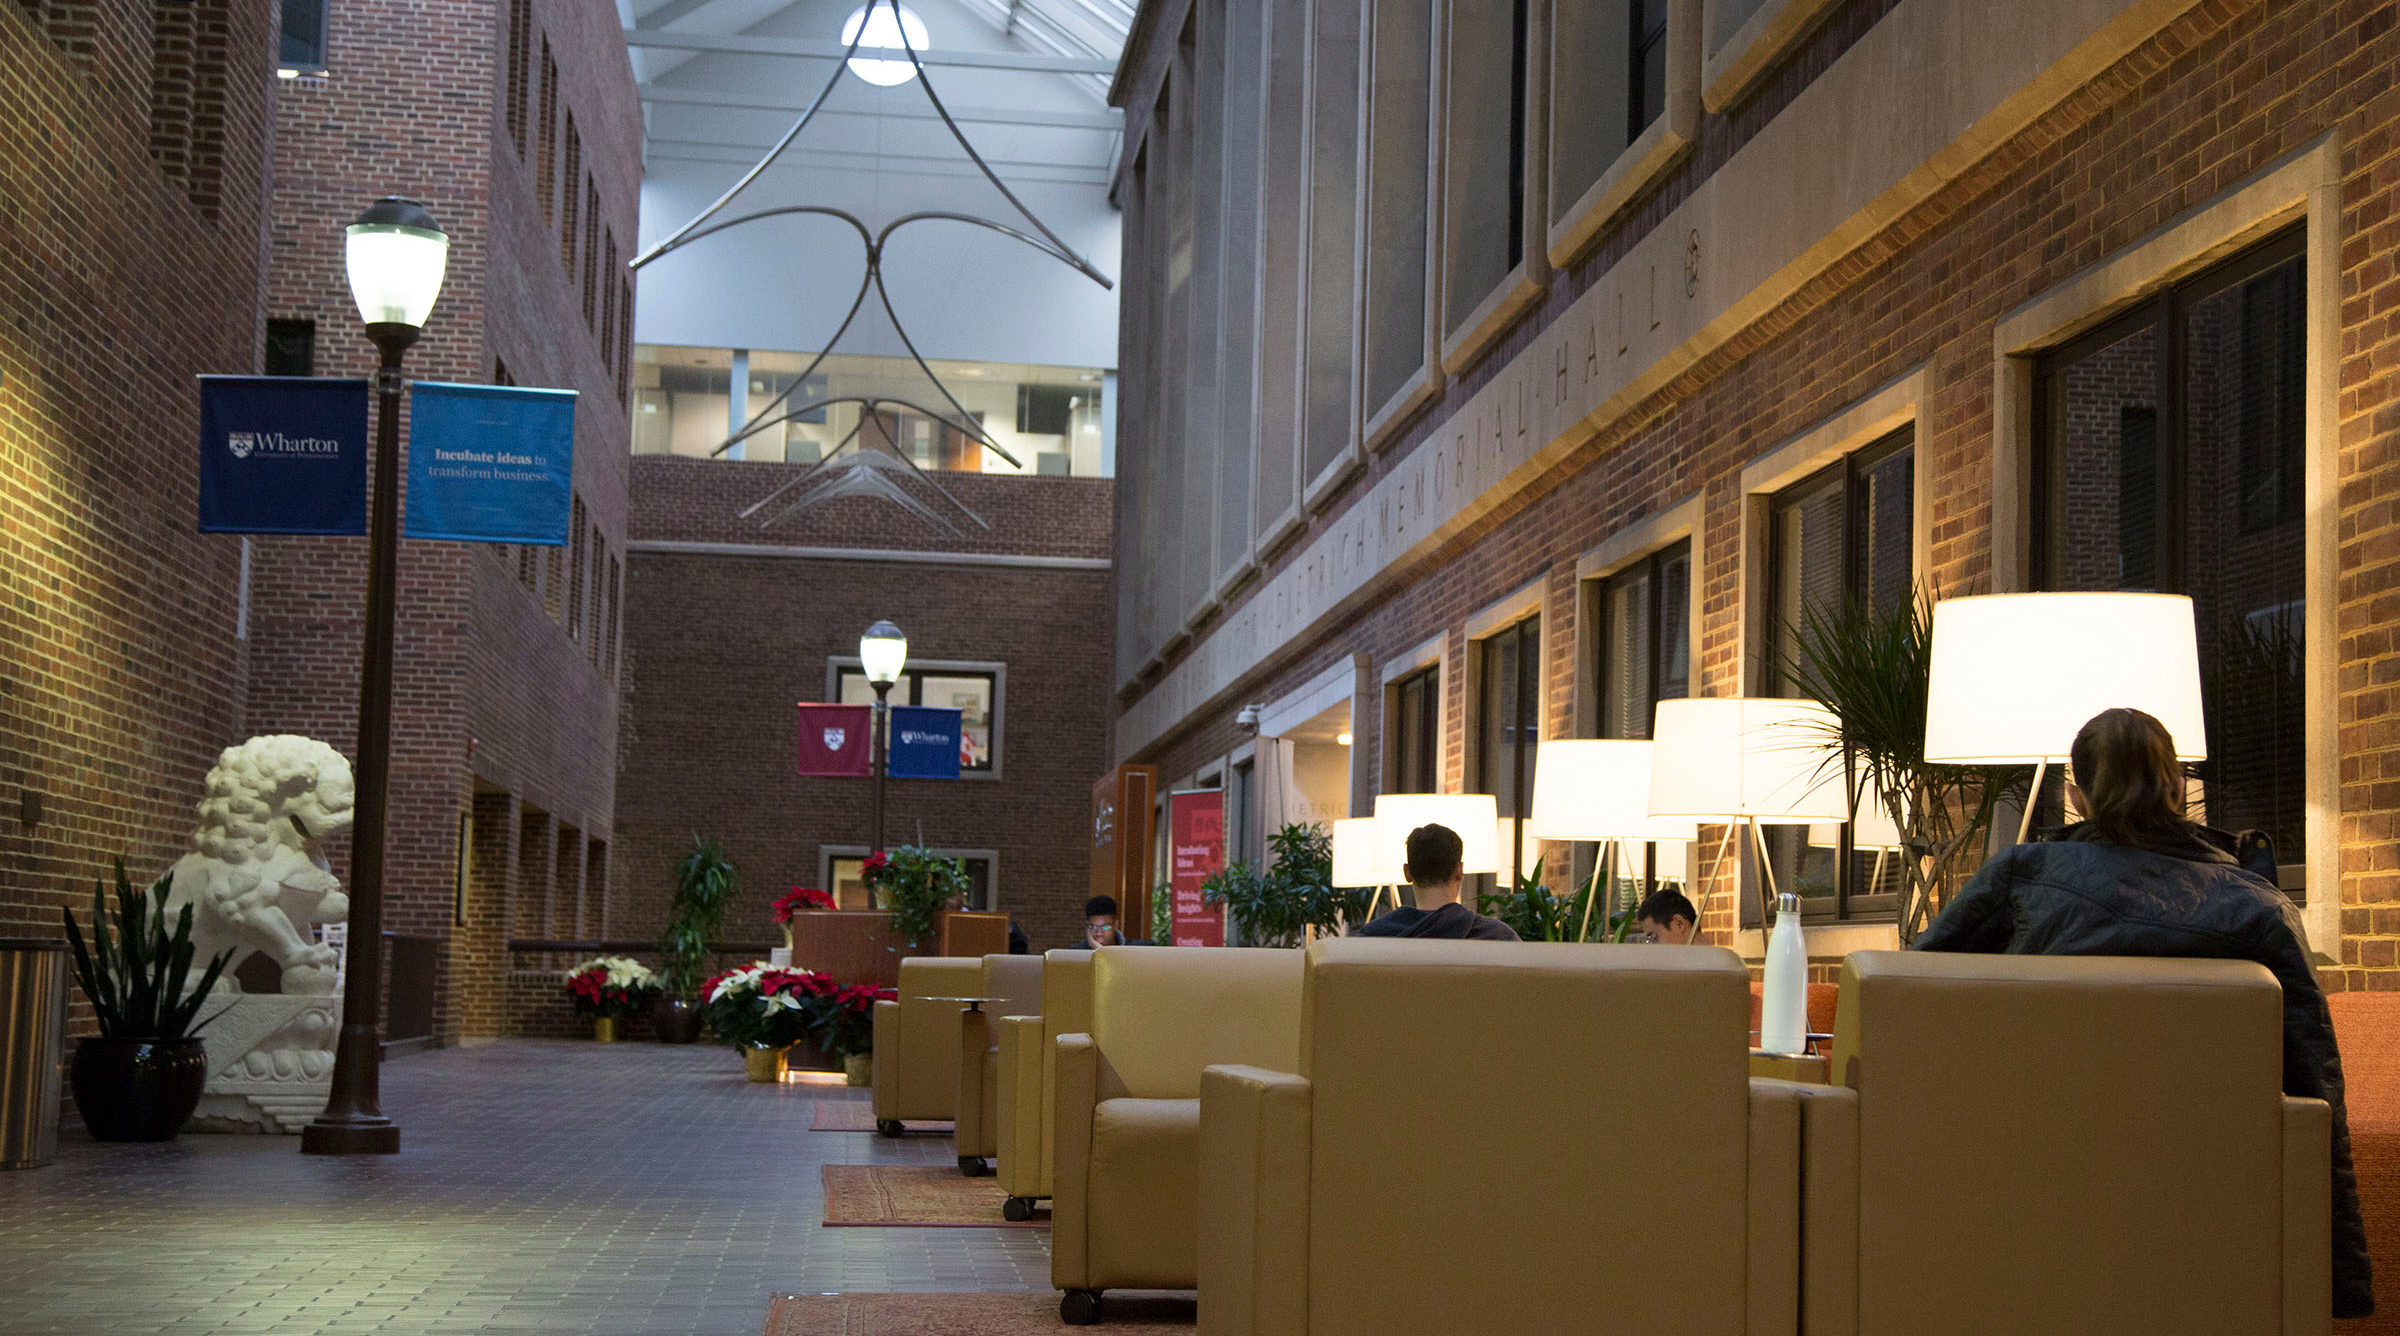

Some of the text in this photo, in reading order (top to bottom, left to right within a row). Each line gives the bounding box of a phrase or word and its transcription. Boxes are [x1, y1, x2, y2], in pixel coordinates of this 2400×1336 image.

[1379, 379, 1526, 546] MEMORIAL
[1555, 265, 1661, 408] HALL
[256, 432, 339, 453] Wharton
[435, 448, 547, 466] Incubate ideas to
[428, 465, 550, 482] transform business.
[912, 731, 950, 742] Wharton
